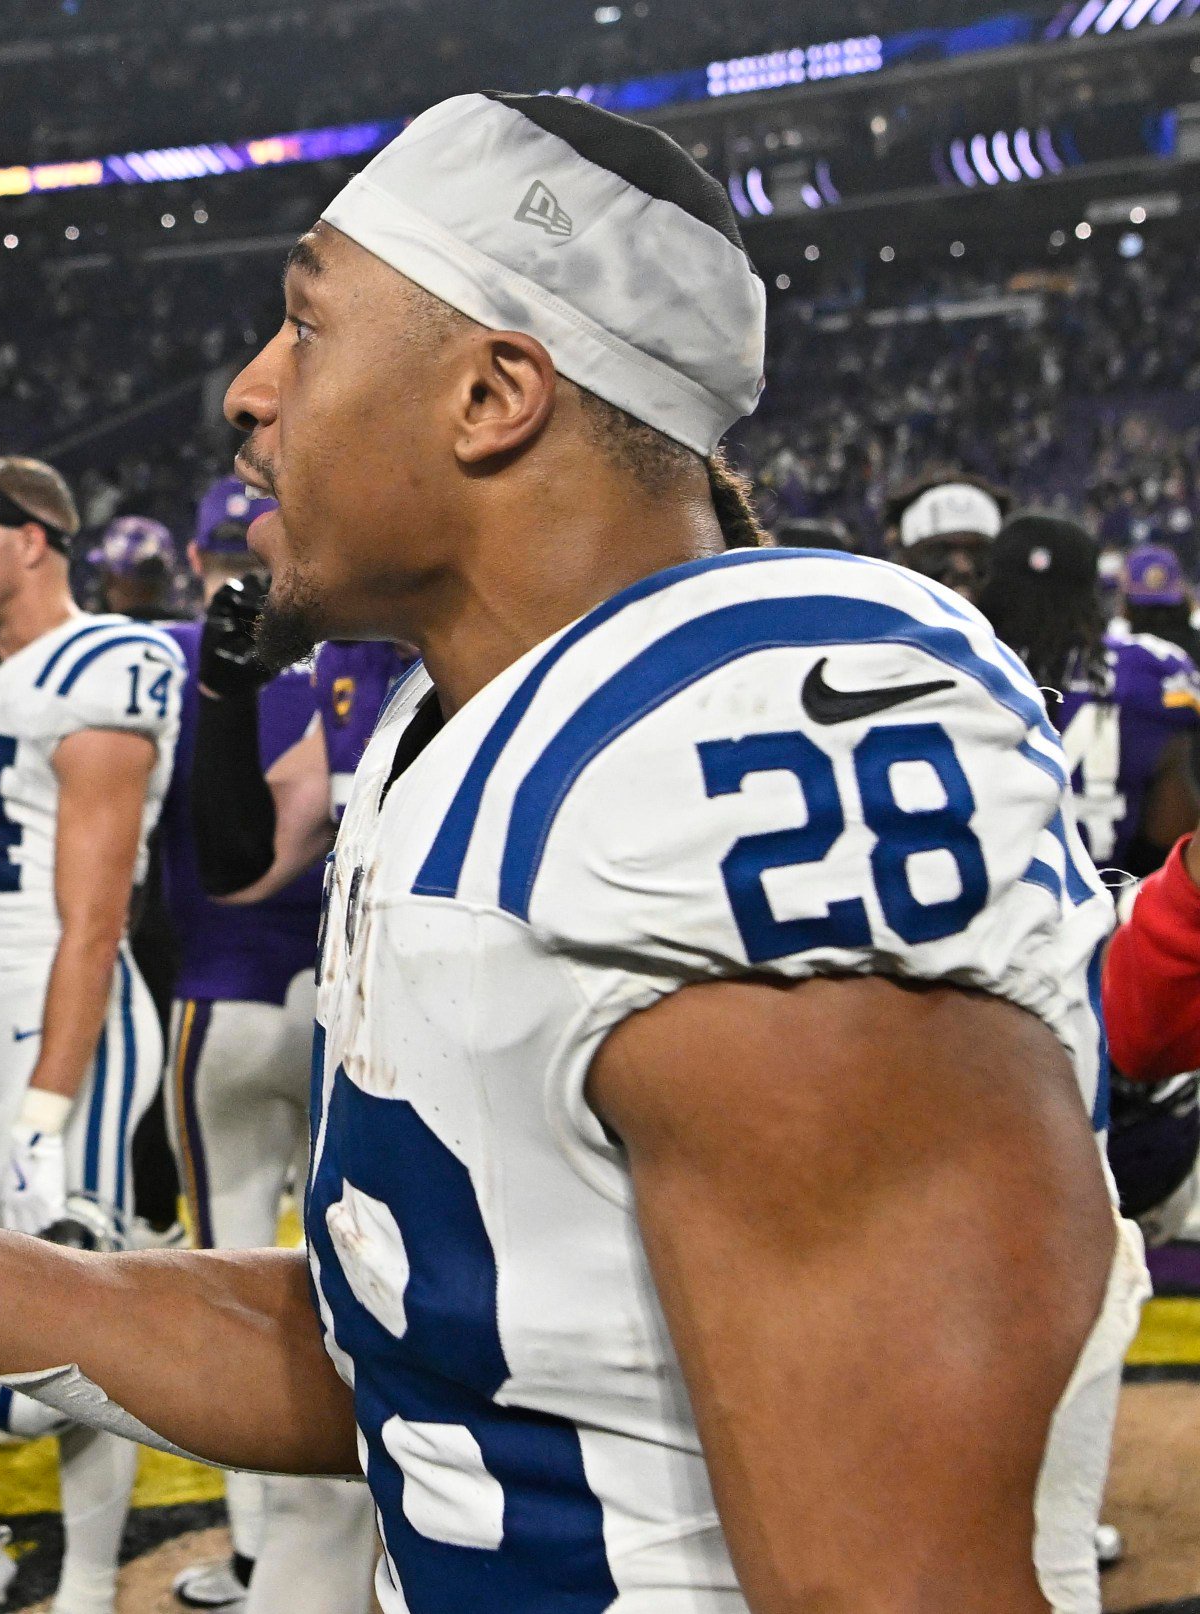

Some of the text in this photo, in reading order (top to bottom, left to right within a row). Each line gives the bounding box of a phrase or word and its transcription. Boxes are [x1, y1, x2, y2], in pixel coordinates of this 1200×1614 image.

[127, 664, 172, 719] 14
[695, 722, 990, 964] 28
[306, 1017, 620, 1614] 8
